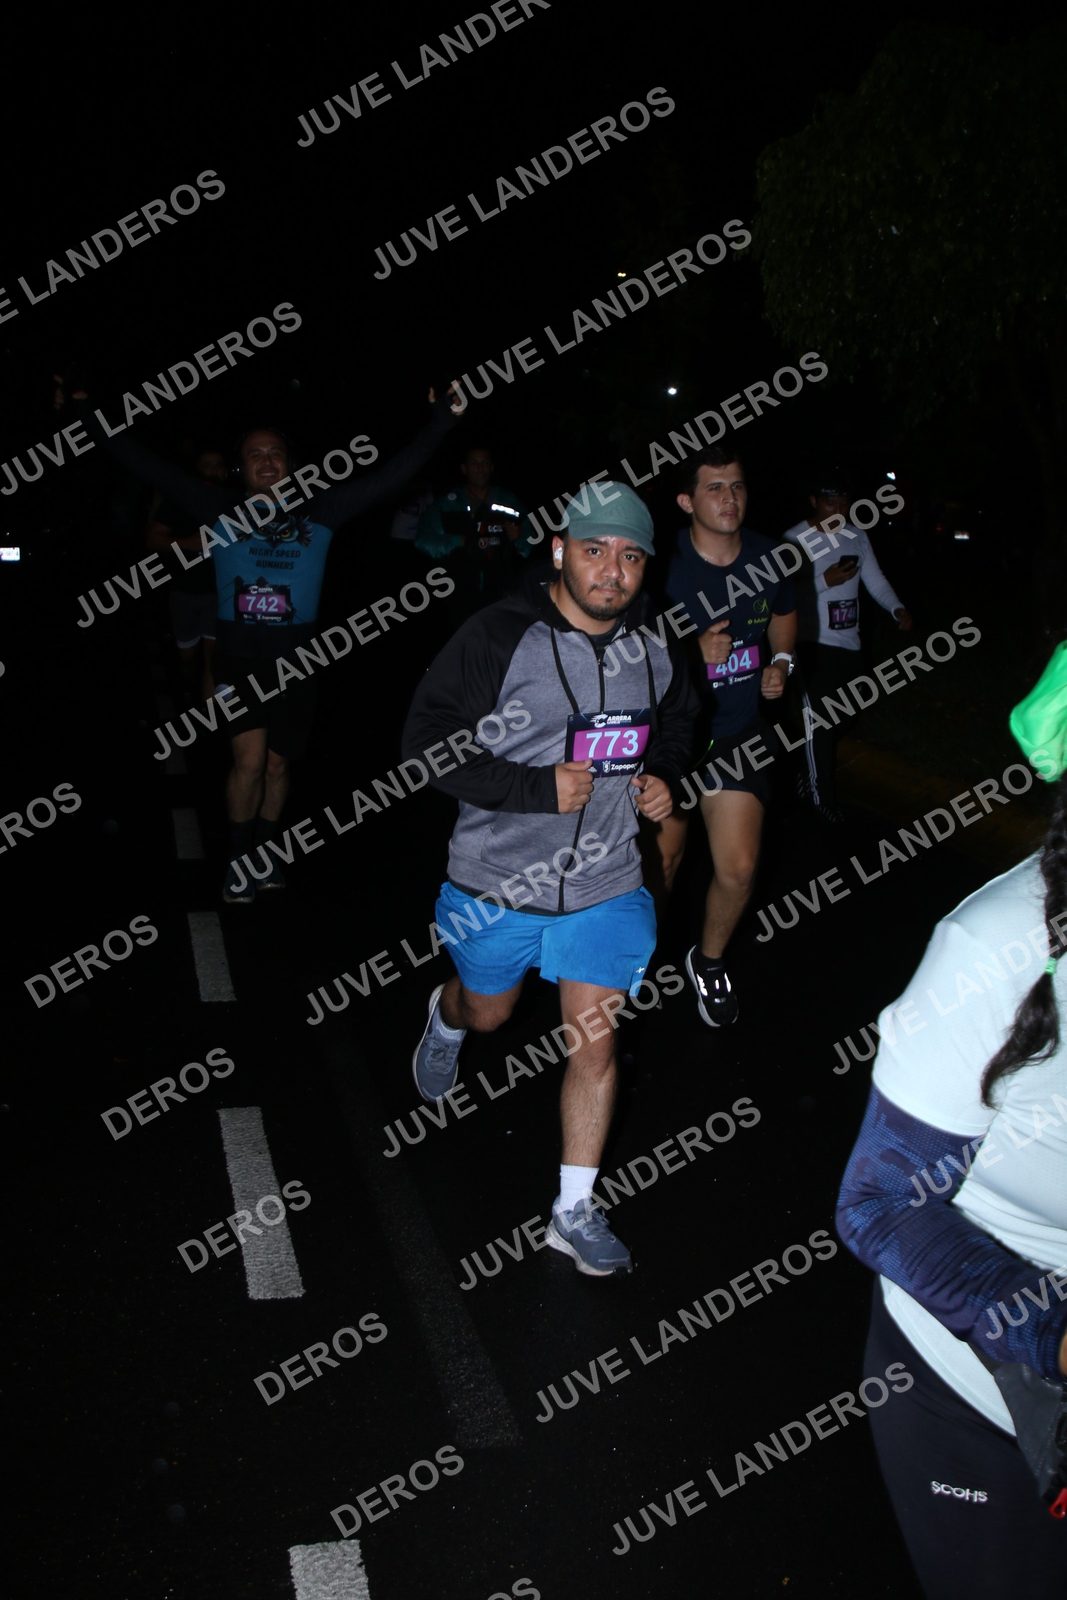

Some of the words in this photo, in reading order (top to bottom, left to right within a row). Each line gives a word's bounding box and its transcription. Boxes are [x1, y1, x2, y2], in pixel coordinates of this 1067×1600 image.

[246, 595, 279, 613] 742
[715, 649, 752, 675] 404
[585, 729, 639, 758] 773
